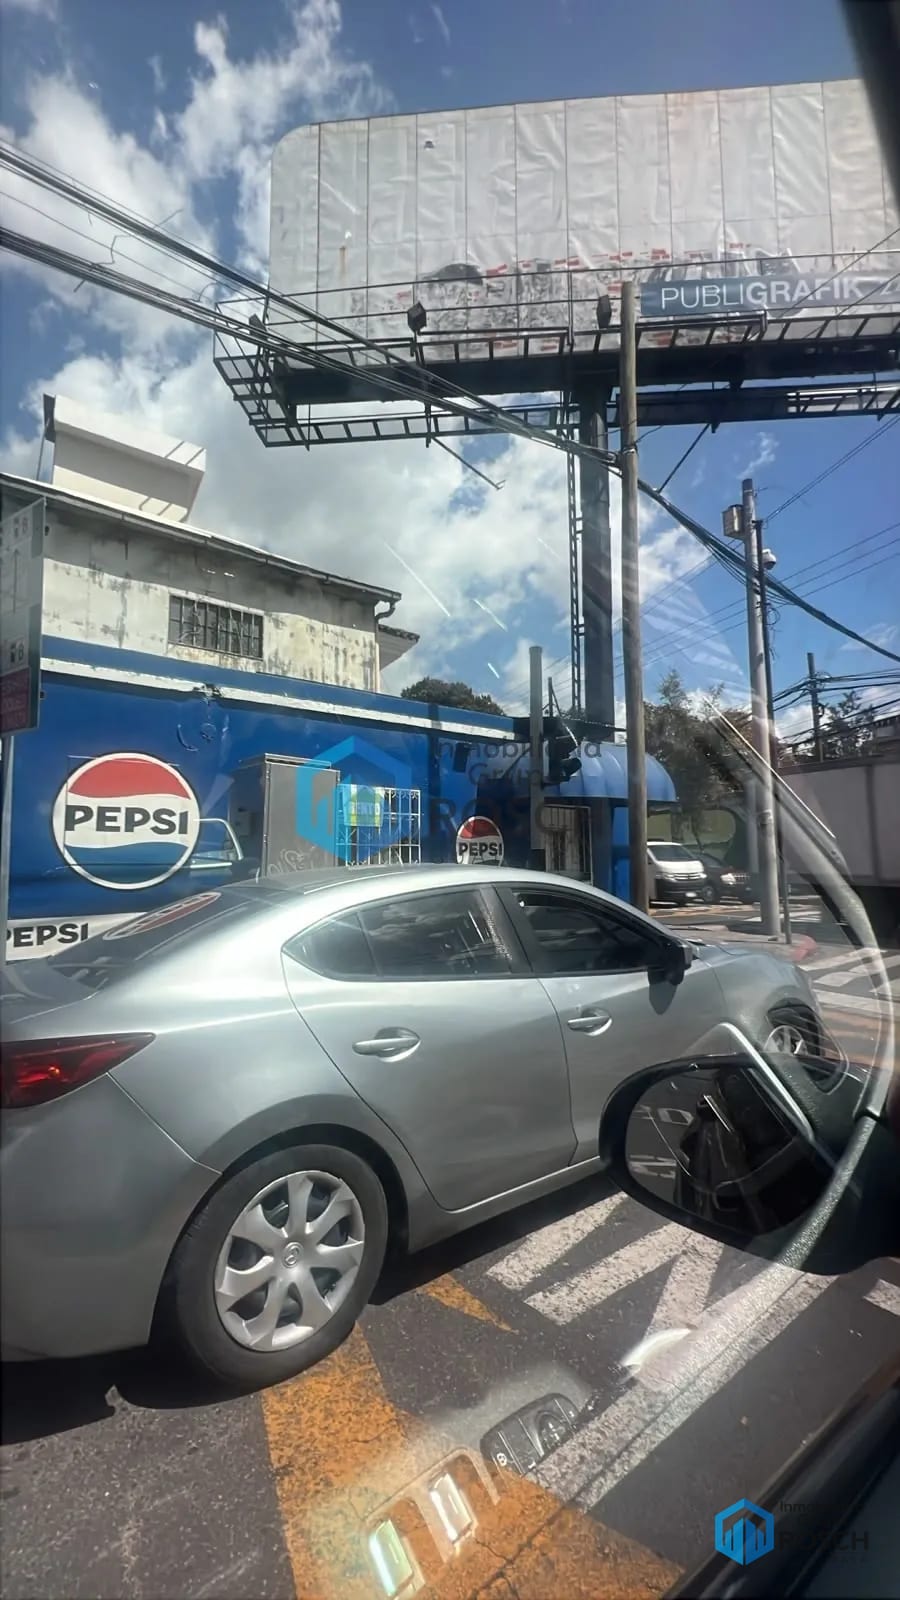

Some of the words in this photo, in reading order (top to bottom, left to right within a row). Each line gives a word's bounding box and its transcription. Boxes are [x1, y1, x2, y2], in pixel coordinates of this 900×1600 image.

[661, 276, 864, 310] PUBLIGRAFIK
[64, 804, 189, 835] PEPSI
[458, 842, 503, 857] PEPSI
[6, 923, 89, 948] EPSI
